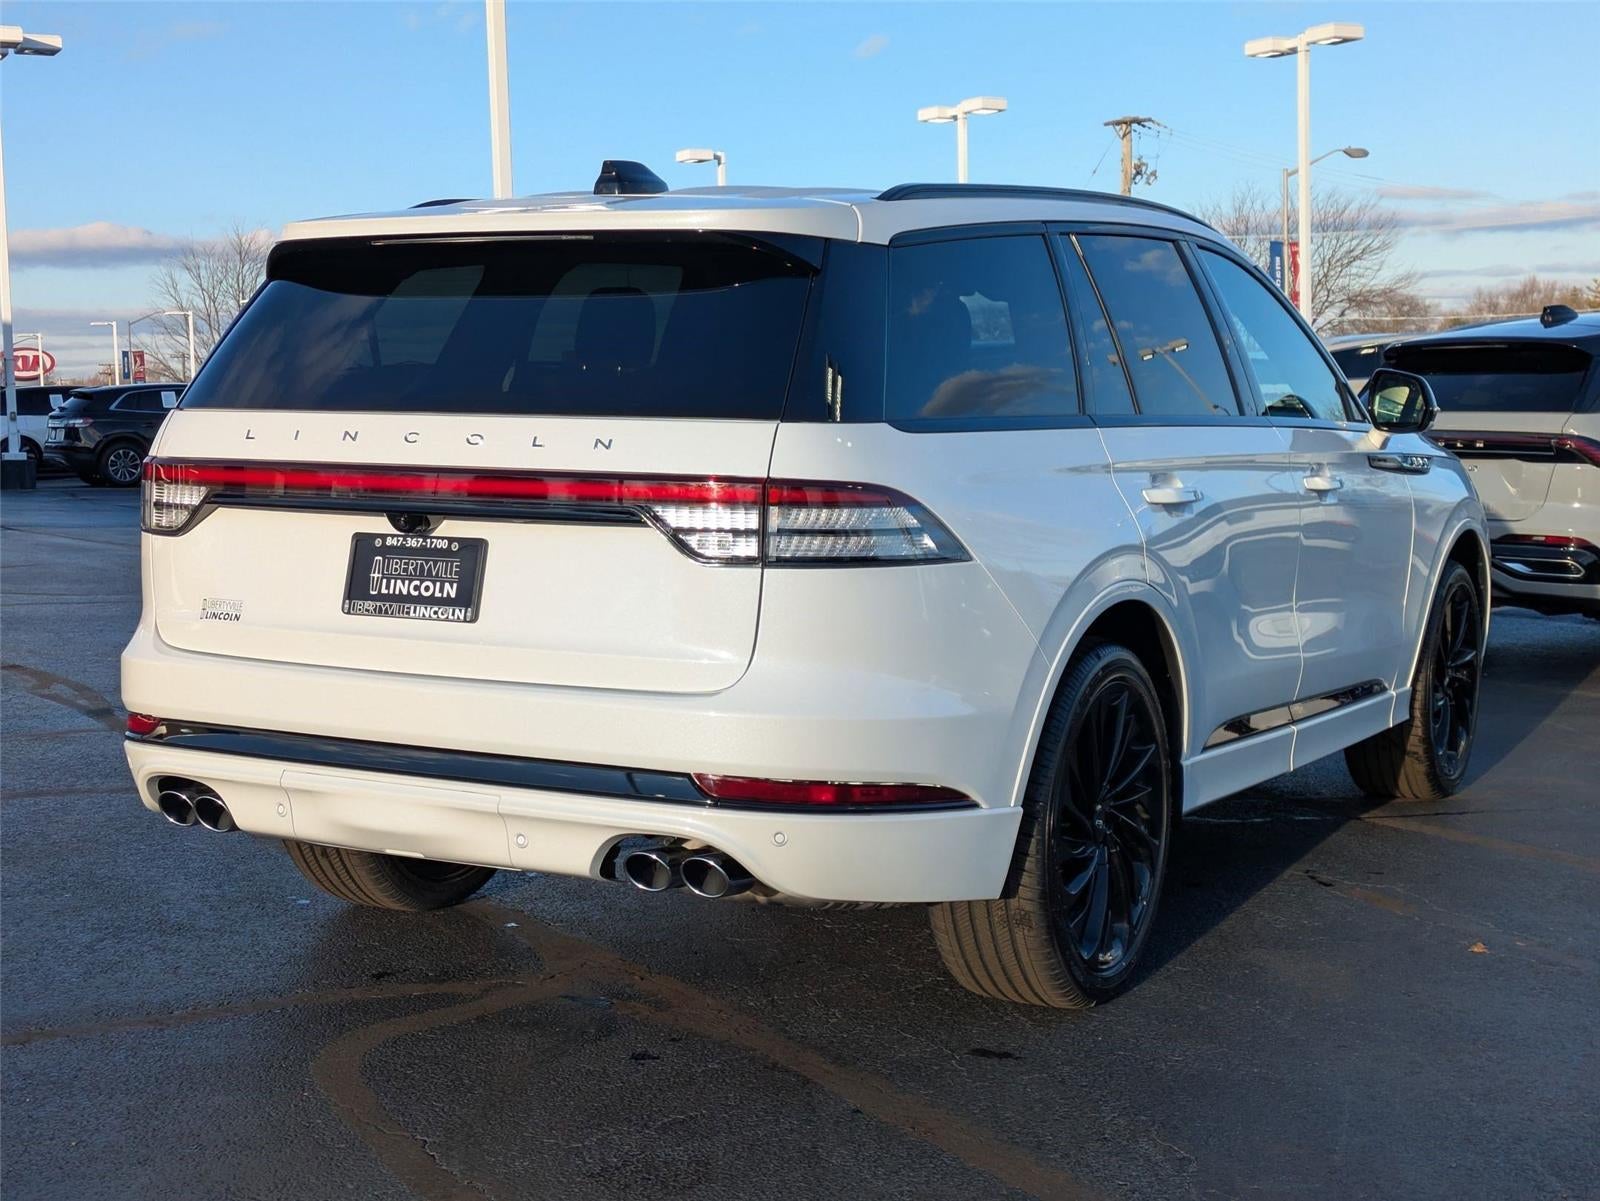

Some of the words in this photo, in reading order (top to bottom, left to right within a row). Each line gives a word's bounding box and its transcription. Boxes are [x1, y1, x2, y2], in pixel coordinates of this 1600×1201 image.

[245, 429, 613, 451] LINCOLN
[385, 536, 449, 549] 847-367-1700
[383, 557, 461, 579] LIBERTYVILLE
[380, 578, 458, 599] LINCOLN
[205, 611, 241, 621] LINCOLN
[350, 600, 411, 616] LIBERTYVILLE
[409, 605, 465, 621] LINCOLN
